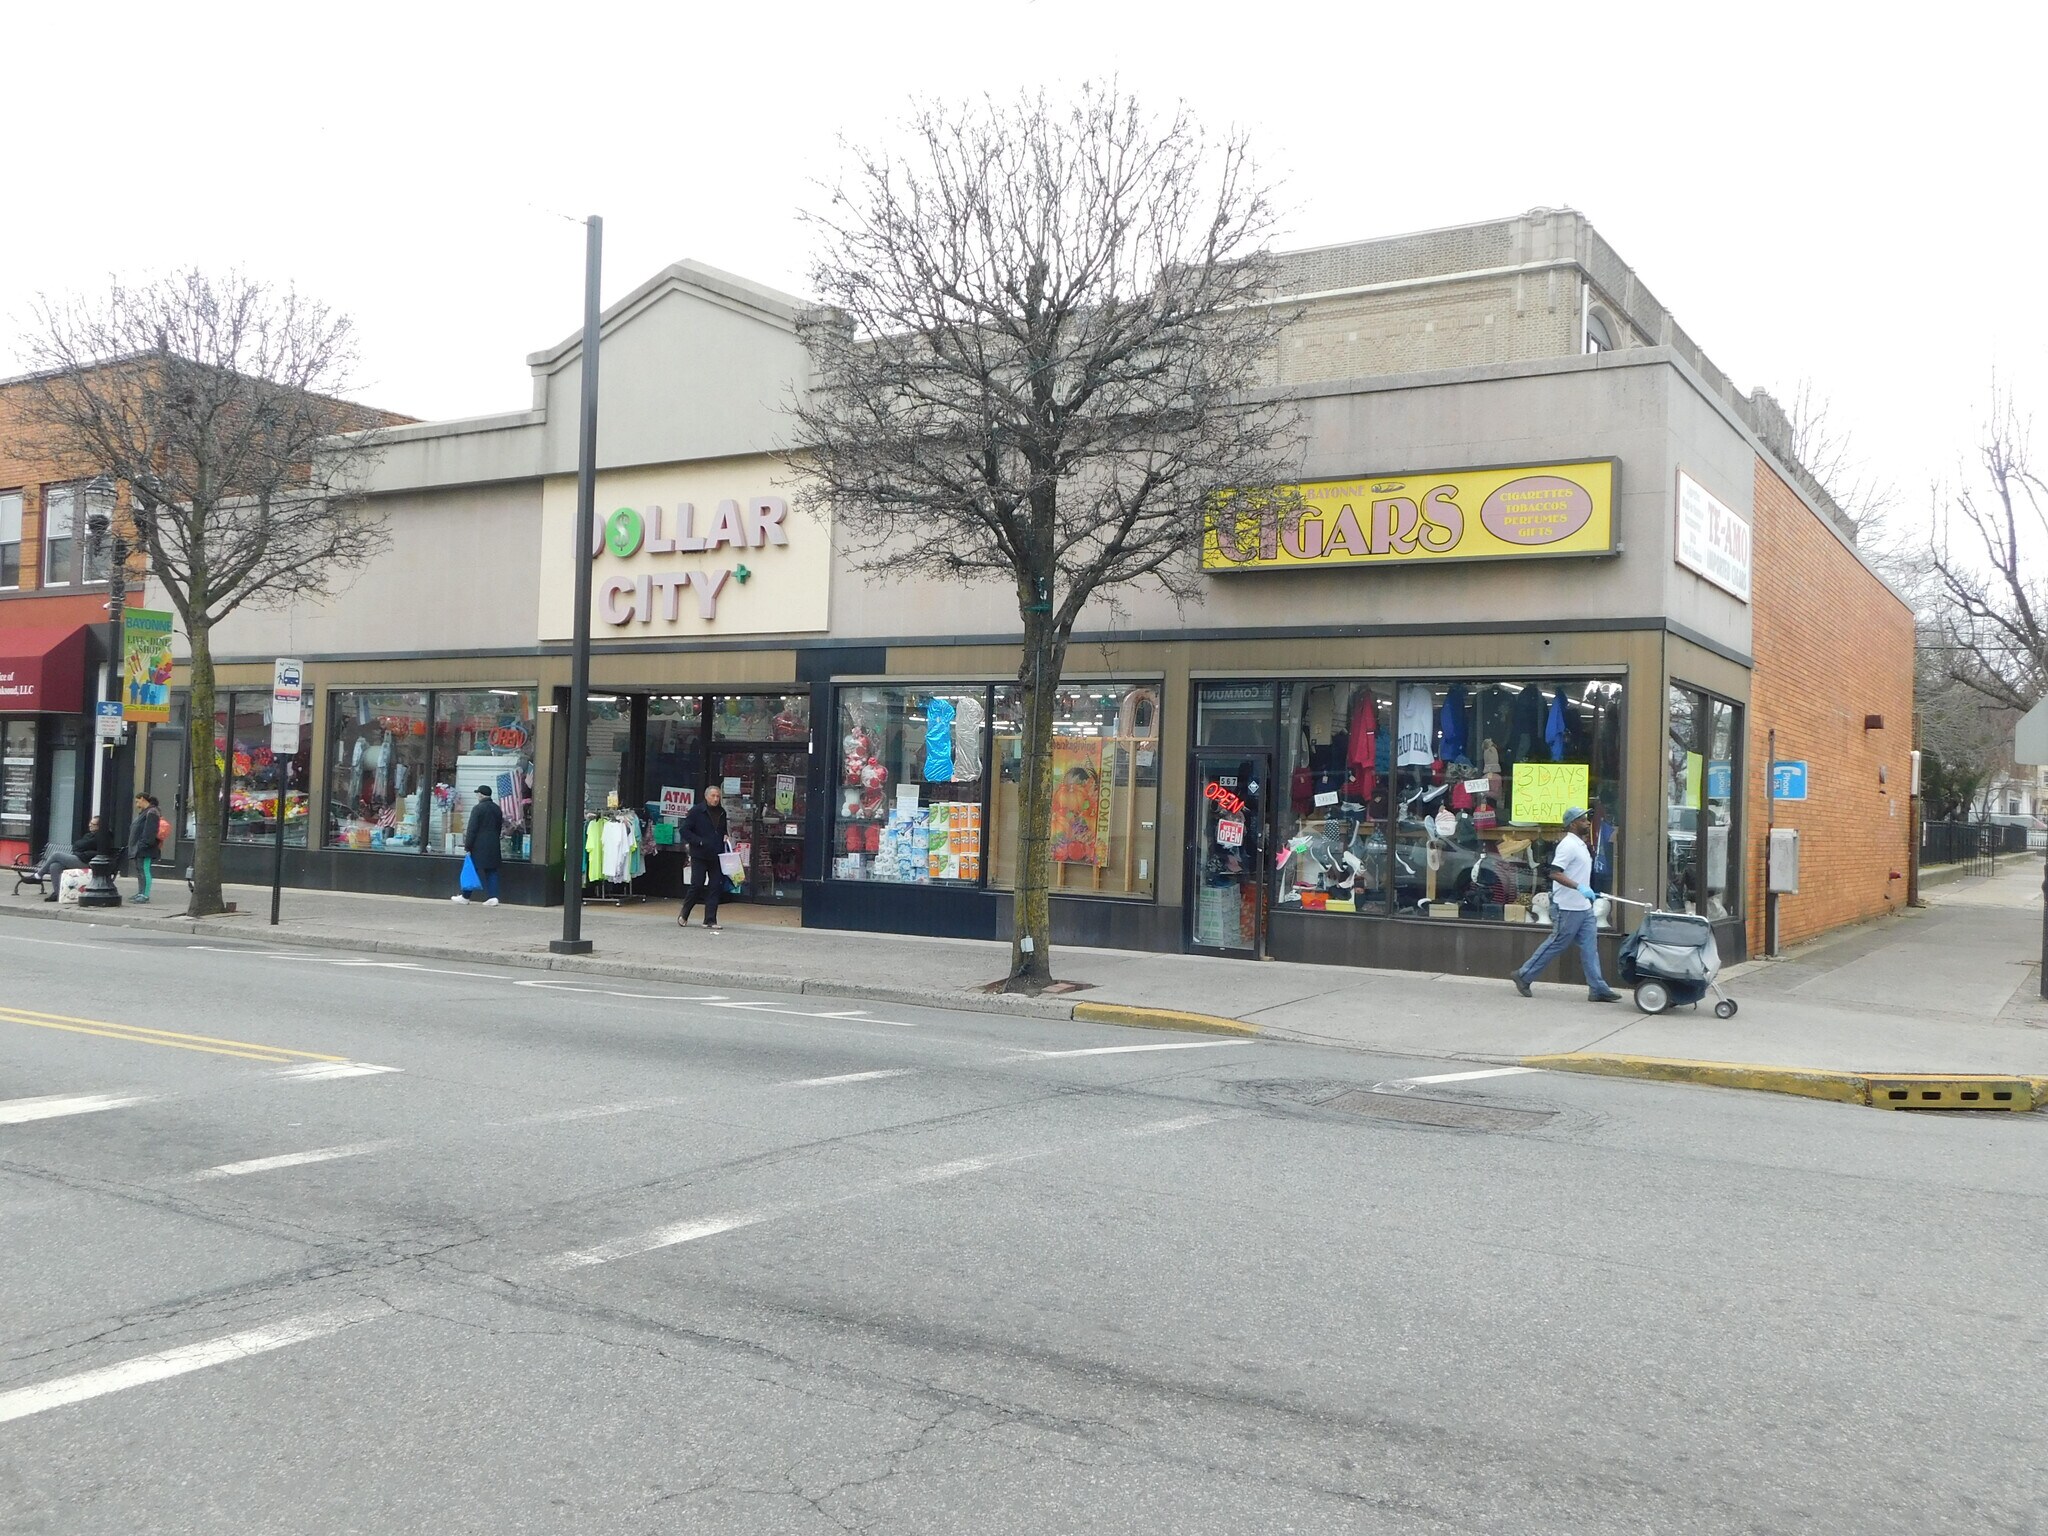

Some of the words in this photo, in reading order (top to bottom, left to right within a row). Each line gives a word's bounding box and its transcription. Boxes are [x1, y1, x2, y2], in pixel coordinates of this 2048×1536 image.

[1307, 485, 1365, 500] BAYONNE
[1500, 488, 1574, 502] CIGARETTES
[1505, 501, 1568, 514] TOBACCOS
[1216, 484, 1465, 562] CIGARS
[1503, 514, 1568, 526] PERFUMES
[1518, 527, 1553, 538] GIFTS
[1708, 500, 1748, 569] TE-AMO
[598, 569, 731, 625] CITY
[126, 616, 172, 632] BAYONNE
[138, 645, 161, 654] SHOP
[20, 685, 34, 695] LLC
[489, 726, 524, 749] OPEN
[1518, 766, 1533, 786] 3
[1537, 766, 1585, 786] DAYS
[1782, 772, 1791, 796] Phone
[663, 790, 691, 804] ATM
[1098, 753, 1114, 833] WELCOME
[1204, 781, 1245, 814] OPEN
[1219, 829, 1241, 844] OPEN
